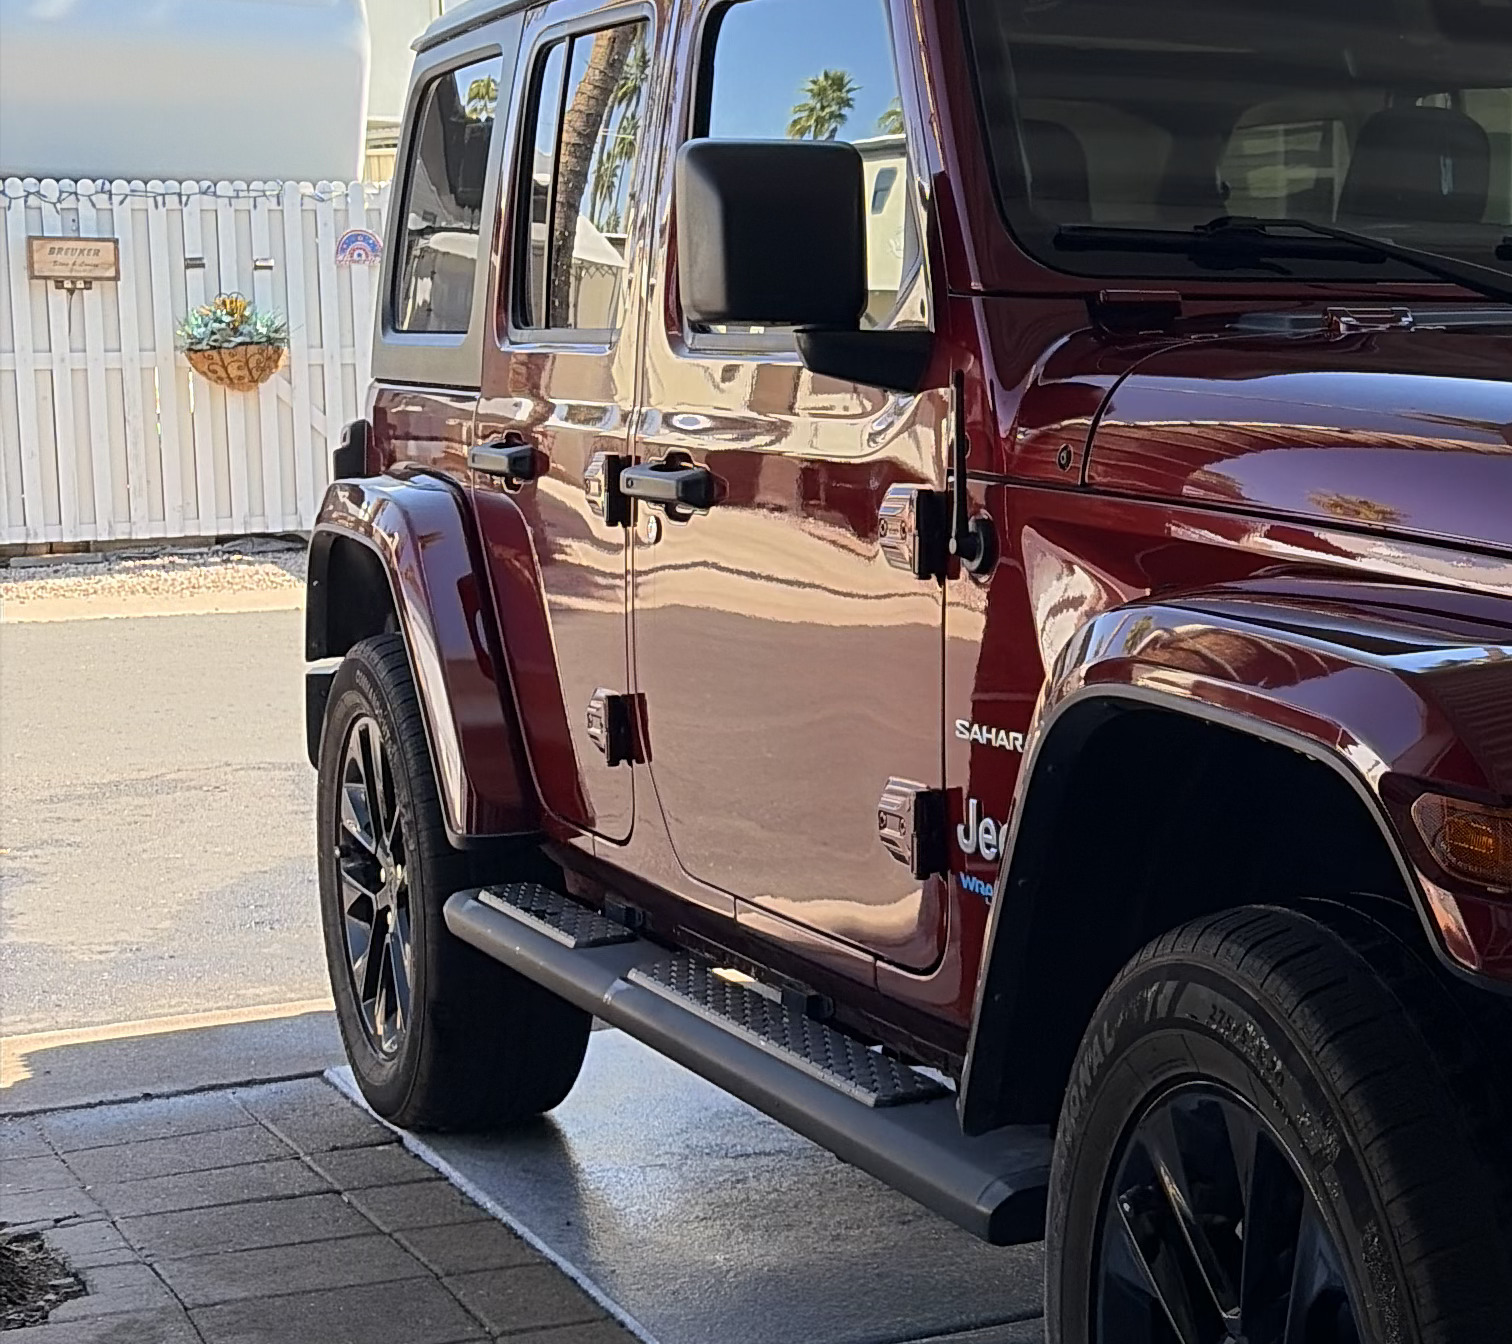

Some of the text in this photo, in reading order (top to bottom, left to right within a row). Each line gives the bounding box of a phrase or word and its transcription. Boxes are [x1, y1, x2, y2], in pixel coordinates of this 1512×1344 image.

[955, 719, 1024, 753] SAHAR
[956, 798, 1007, 861] Je
[960, 871, 993, 897] WRA
